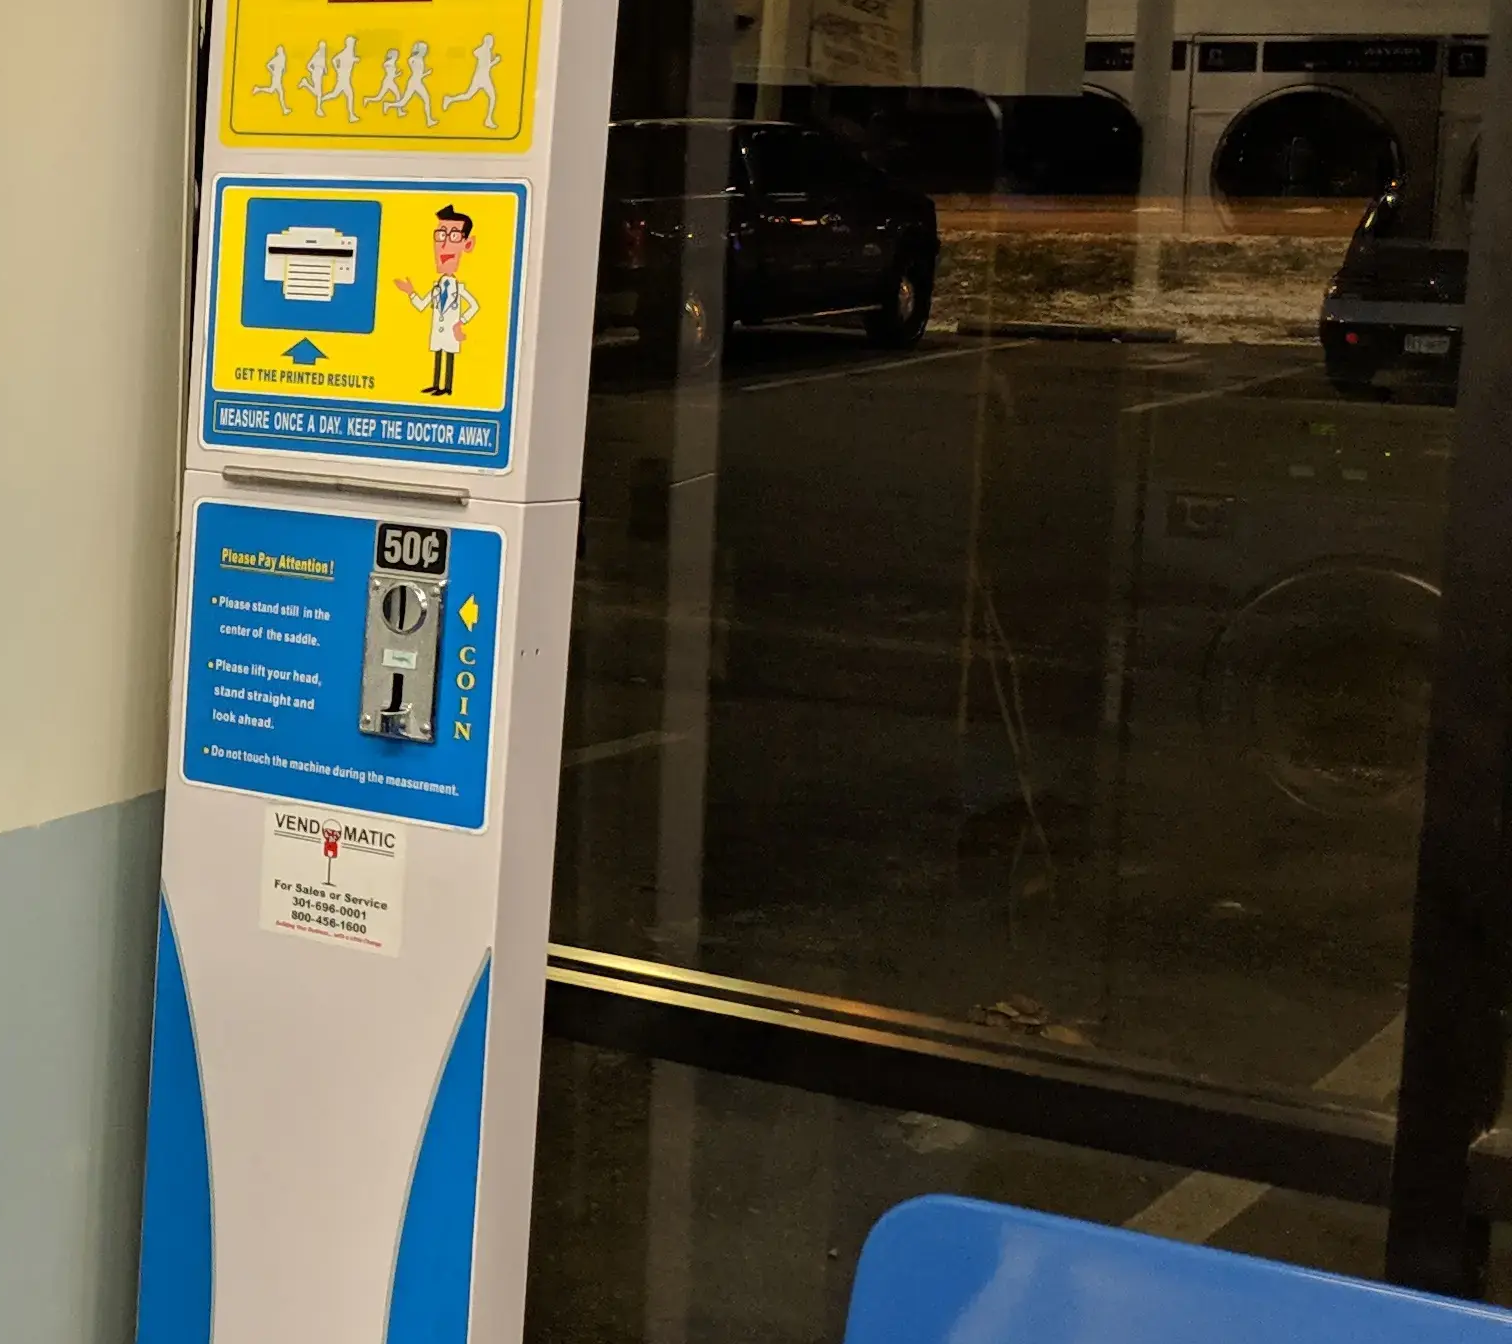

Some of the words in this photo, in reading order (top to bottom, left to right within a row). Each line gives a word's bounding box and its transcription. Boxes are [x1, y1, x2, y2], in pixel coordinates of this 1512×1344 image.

[235, 368, 255, 381] GET
[258, 369, 277, 383] THE
[280, 370, 325, 386] PRINTED
[327, 373, 375, 389] RESULTS
[220, 408, 269, 429] MEASURE
[274, 412, 304, 432] ONCE
[307, 417, 315, 433] A
[319, 416, 343, 435] DAY.
[347, 419, 376, 437] KEEP
[381, 422, 402, 439] THE
[407, 425, 454, 444] DOCTOR
[458, 428, 493, 447] AWAY.
[220, 548, 255, 570] Please
[258, 553, 277, 573] Pay
[384, 528, 440, 568] 50¢
[219, 596, 250, 613] Please
[251, 600, 278, 617] stand
[281, 602, 300, 617] still
[303, 606, 313, 620] in
[315, 607, 330, 621] the
[220, 623, 250, 638] center
[252, 625, 263, 640] of
[266, 627, 282, 642] the
[284, 628, 320, 646] saddle.
[215, 659, 249, 676] Please
[251, 663, 266, 679] lift
[267, 667, 291, 685] your
[293, 667, 322, 687] head,
[213, 685, 244, 701] stand
[246, 688, 291, 709] straight
[294, 695, 315, 711] and
[453, 646, 477, 741] COIN
[212, 708, 237, 725] look
[238, 710, 274, 730] ahead.
[211, 745, 224, 760] Do
[225, 748, 241, 762] not
[243, 750, 271, 769] touch
[272, 753, 288, 769] the
[289, 756, 331, 777] machine
[332, 765, 366, 784] during
[368, 770, 384, 785] the
[385, 774, 459, 796] measurement.
[274, 879, 292, 891] For
[296, 883, 325, 897] Sales
[329, 892, 341, 900] or
[345, 893, 388, 910] Service
[292, 897, 367, 920] 301-696-0001
